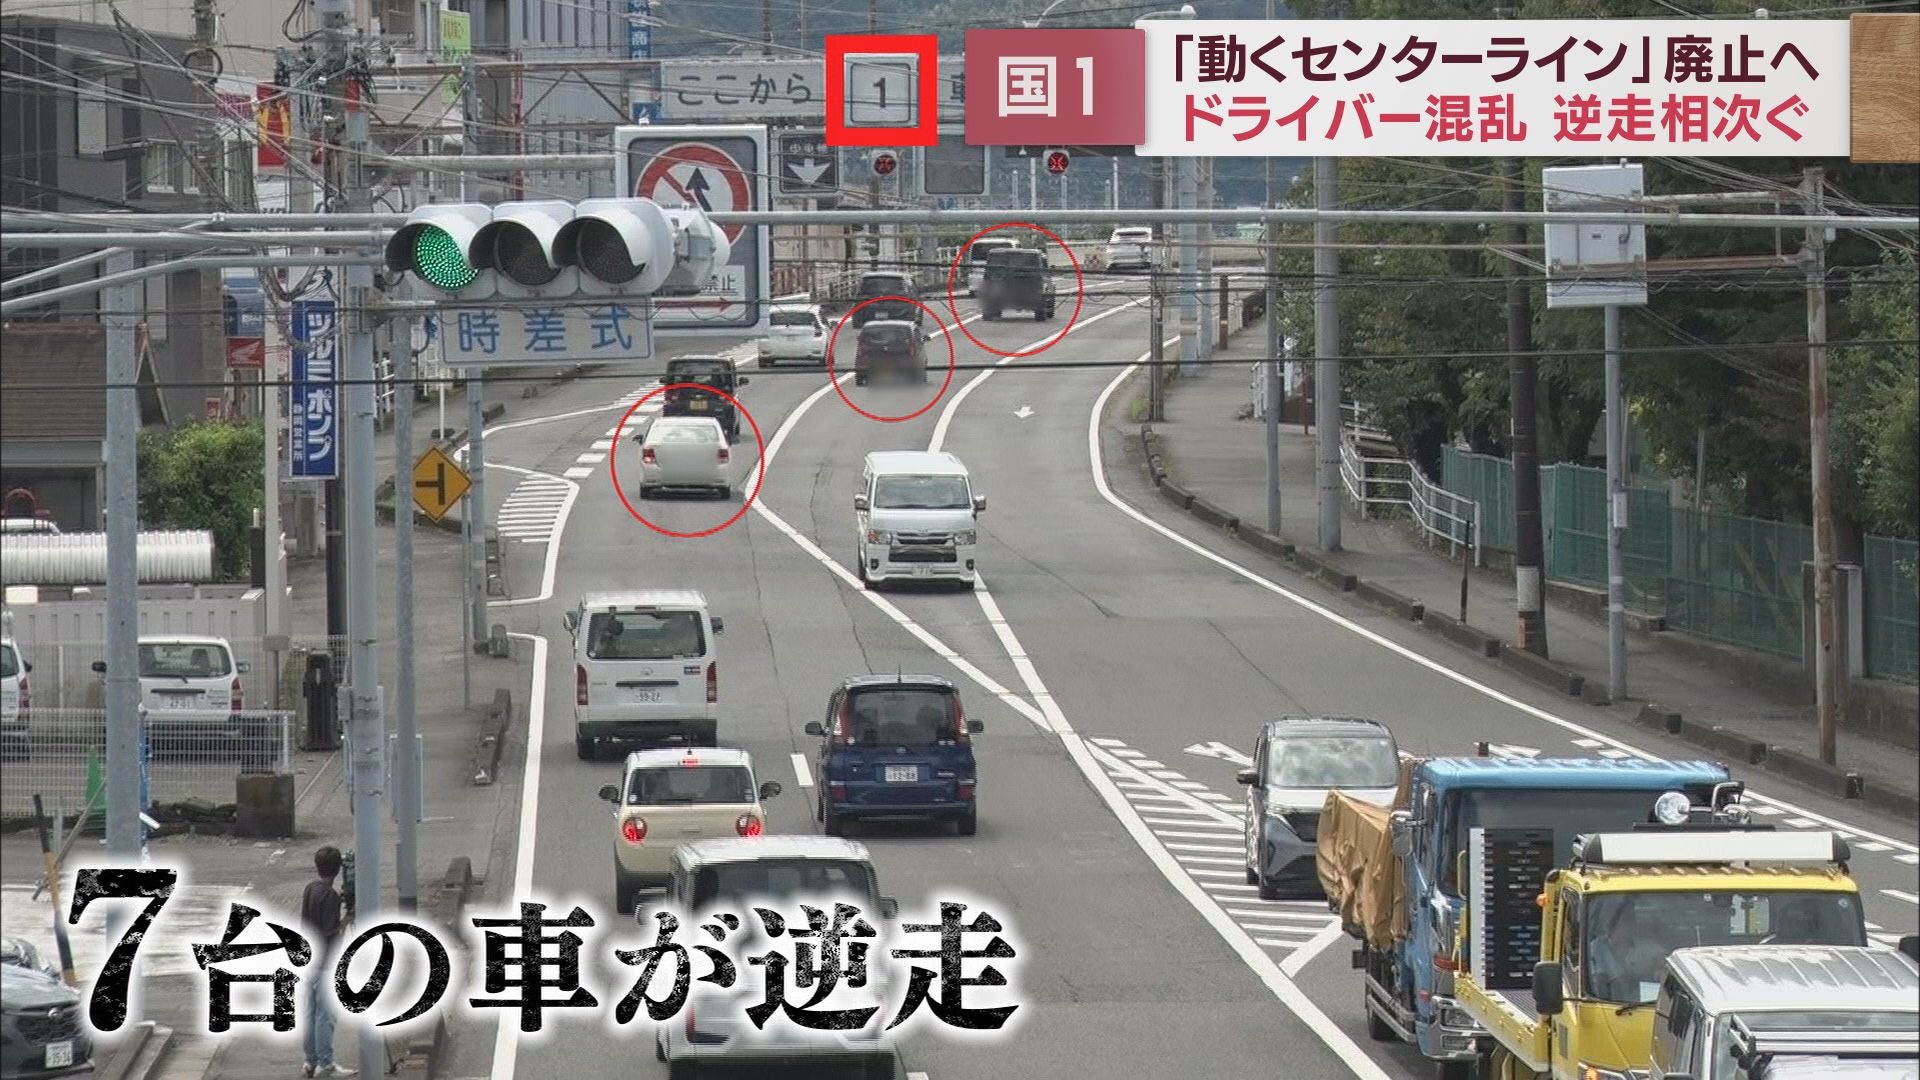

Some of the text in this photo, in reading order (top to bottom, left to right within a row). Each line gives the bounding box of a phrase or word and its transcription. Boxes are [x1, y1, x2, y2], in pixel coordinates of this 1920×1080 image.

[677, 73, 812, 105] ここから
[872, 76, 888, 109] 1
[457, 303, 633, 355] 時差式
[307, 313, 334, 462] ツルミポンプ
